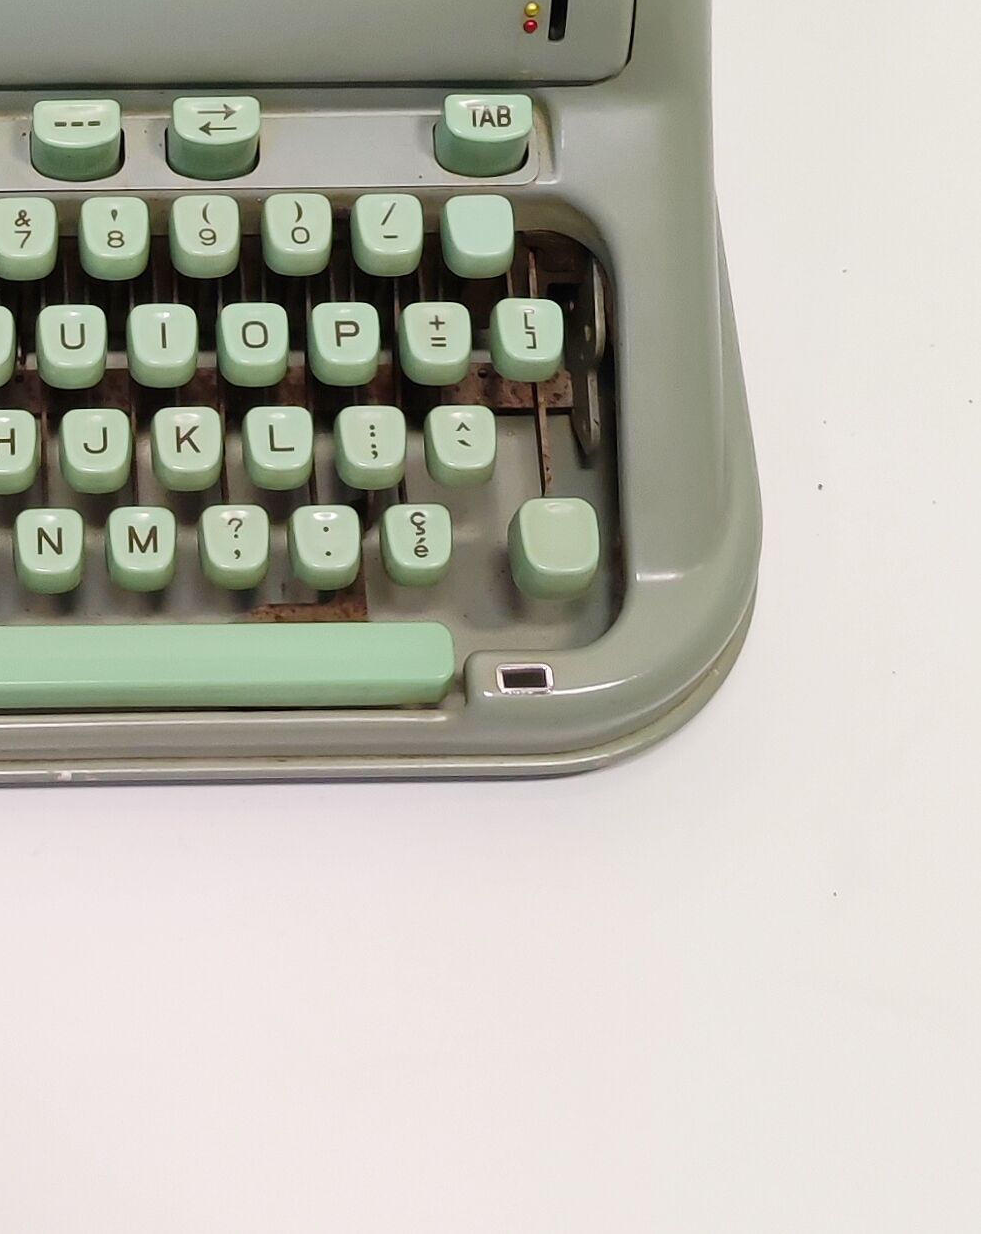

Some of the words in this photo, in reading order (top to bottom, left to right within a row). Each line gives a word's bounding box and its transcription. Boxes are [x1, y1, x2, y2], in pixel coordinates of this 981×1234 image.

[469, 105, 512, 128] TAB
[14, 209, 31, 227] &
[14, 230, 32, 249] 7
[106, 230, 125, 249] 8
[198, 228, 217, 246] 9
[291, 226, 310, 245] 0
[60, 323, 86, 350] U
[241, 320, 269, 349] O
[334, 320, 360, 348] P
[83, 426, 108, 455] J
[175, 425, 201, 454] K
[268, 424, 295, 452] L
[227, 517, 243, 539] ?
[37, 527, 63, 556] N
[127, 525, 158, 554] M
